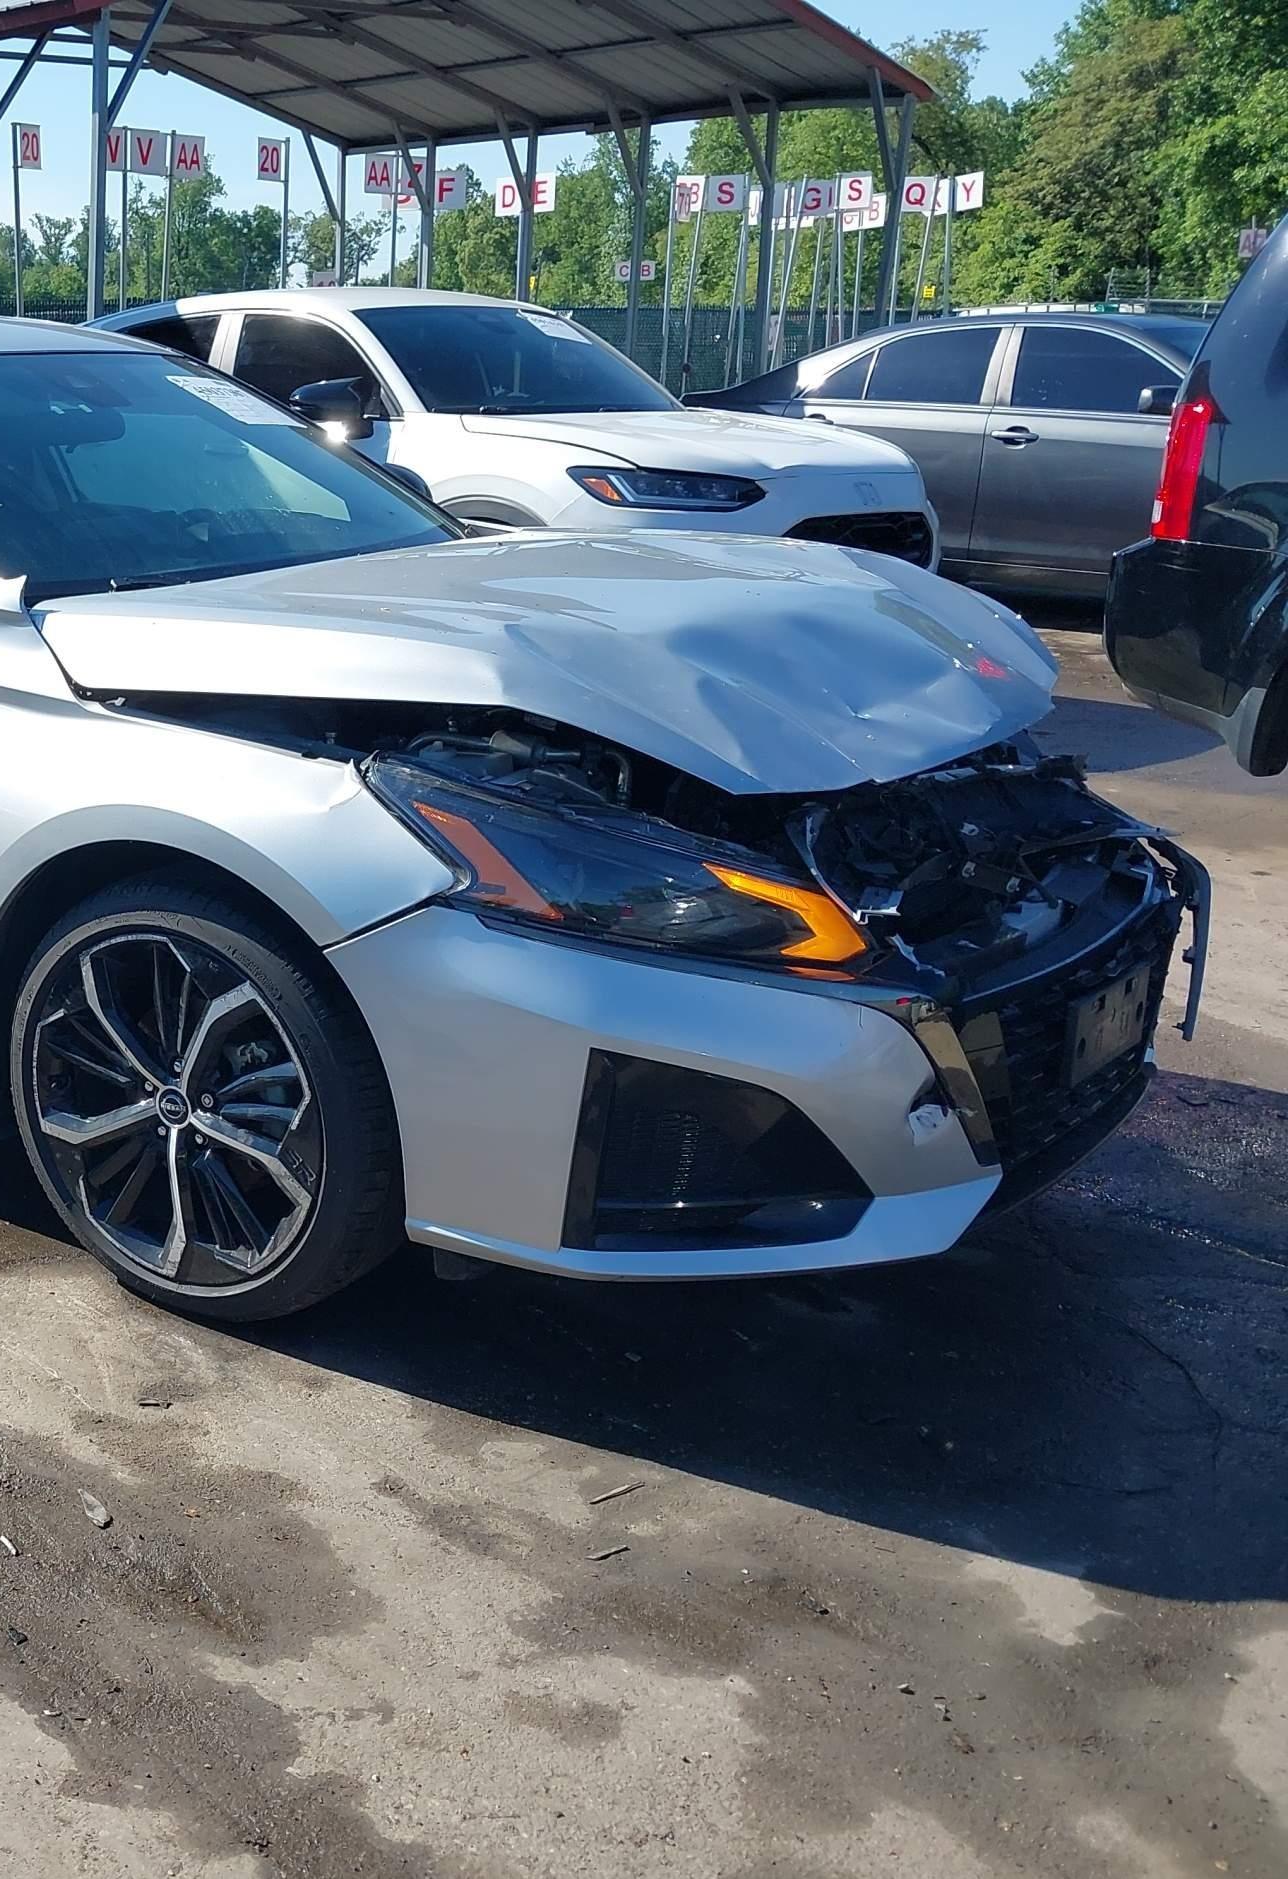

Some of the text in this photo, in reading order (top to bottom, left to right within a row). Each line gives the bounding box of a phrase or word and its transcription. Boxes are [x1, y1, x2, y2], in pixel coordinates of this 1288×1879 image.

[22, 131, 39, 162] 20
[107, 135, 121, 163] V
[136, 136, 153, 165] V
[176, 142, 200, 171] AA
[260, 145, 279, 173] 20
[367, 160, 390, 187] AA
[438, 177, 455, 203] F
[502, 185, 515, 208] D
[533, 180, 548, 204] E
[717, 182, 735, 204] S
[805, 187, 821, 210] G
[848, 179, 863, 201] S
[905, 183, 925, 206] Q
[961, 180, 976, 202] Y
[619, 264, 630, 277] C
[641, 264, 651, 277] B
